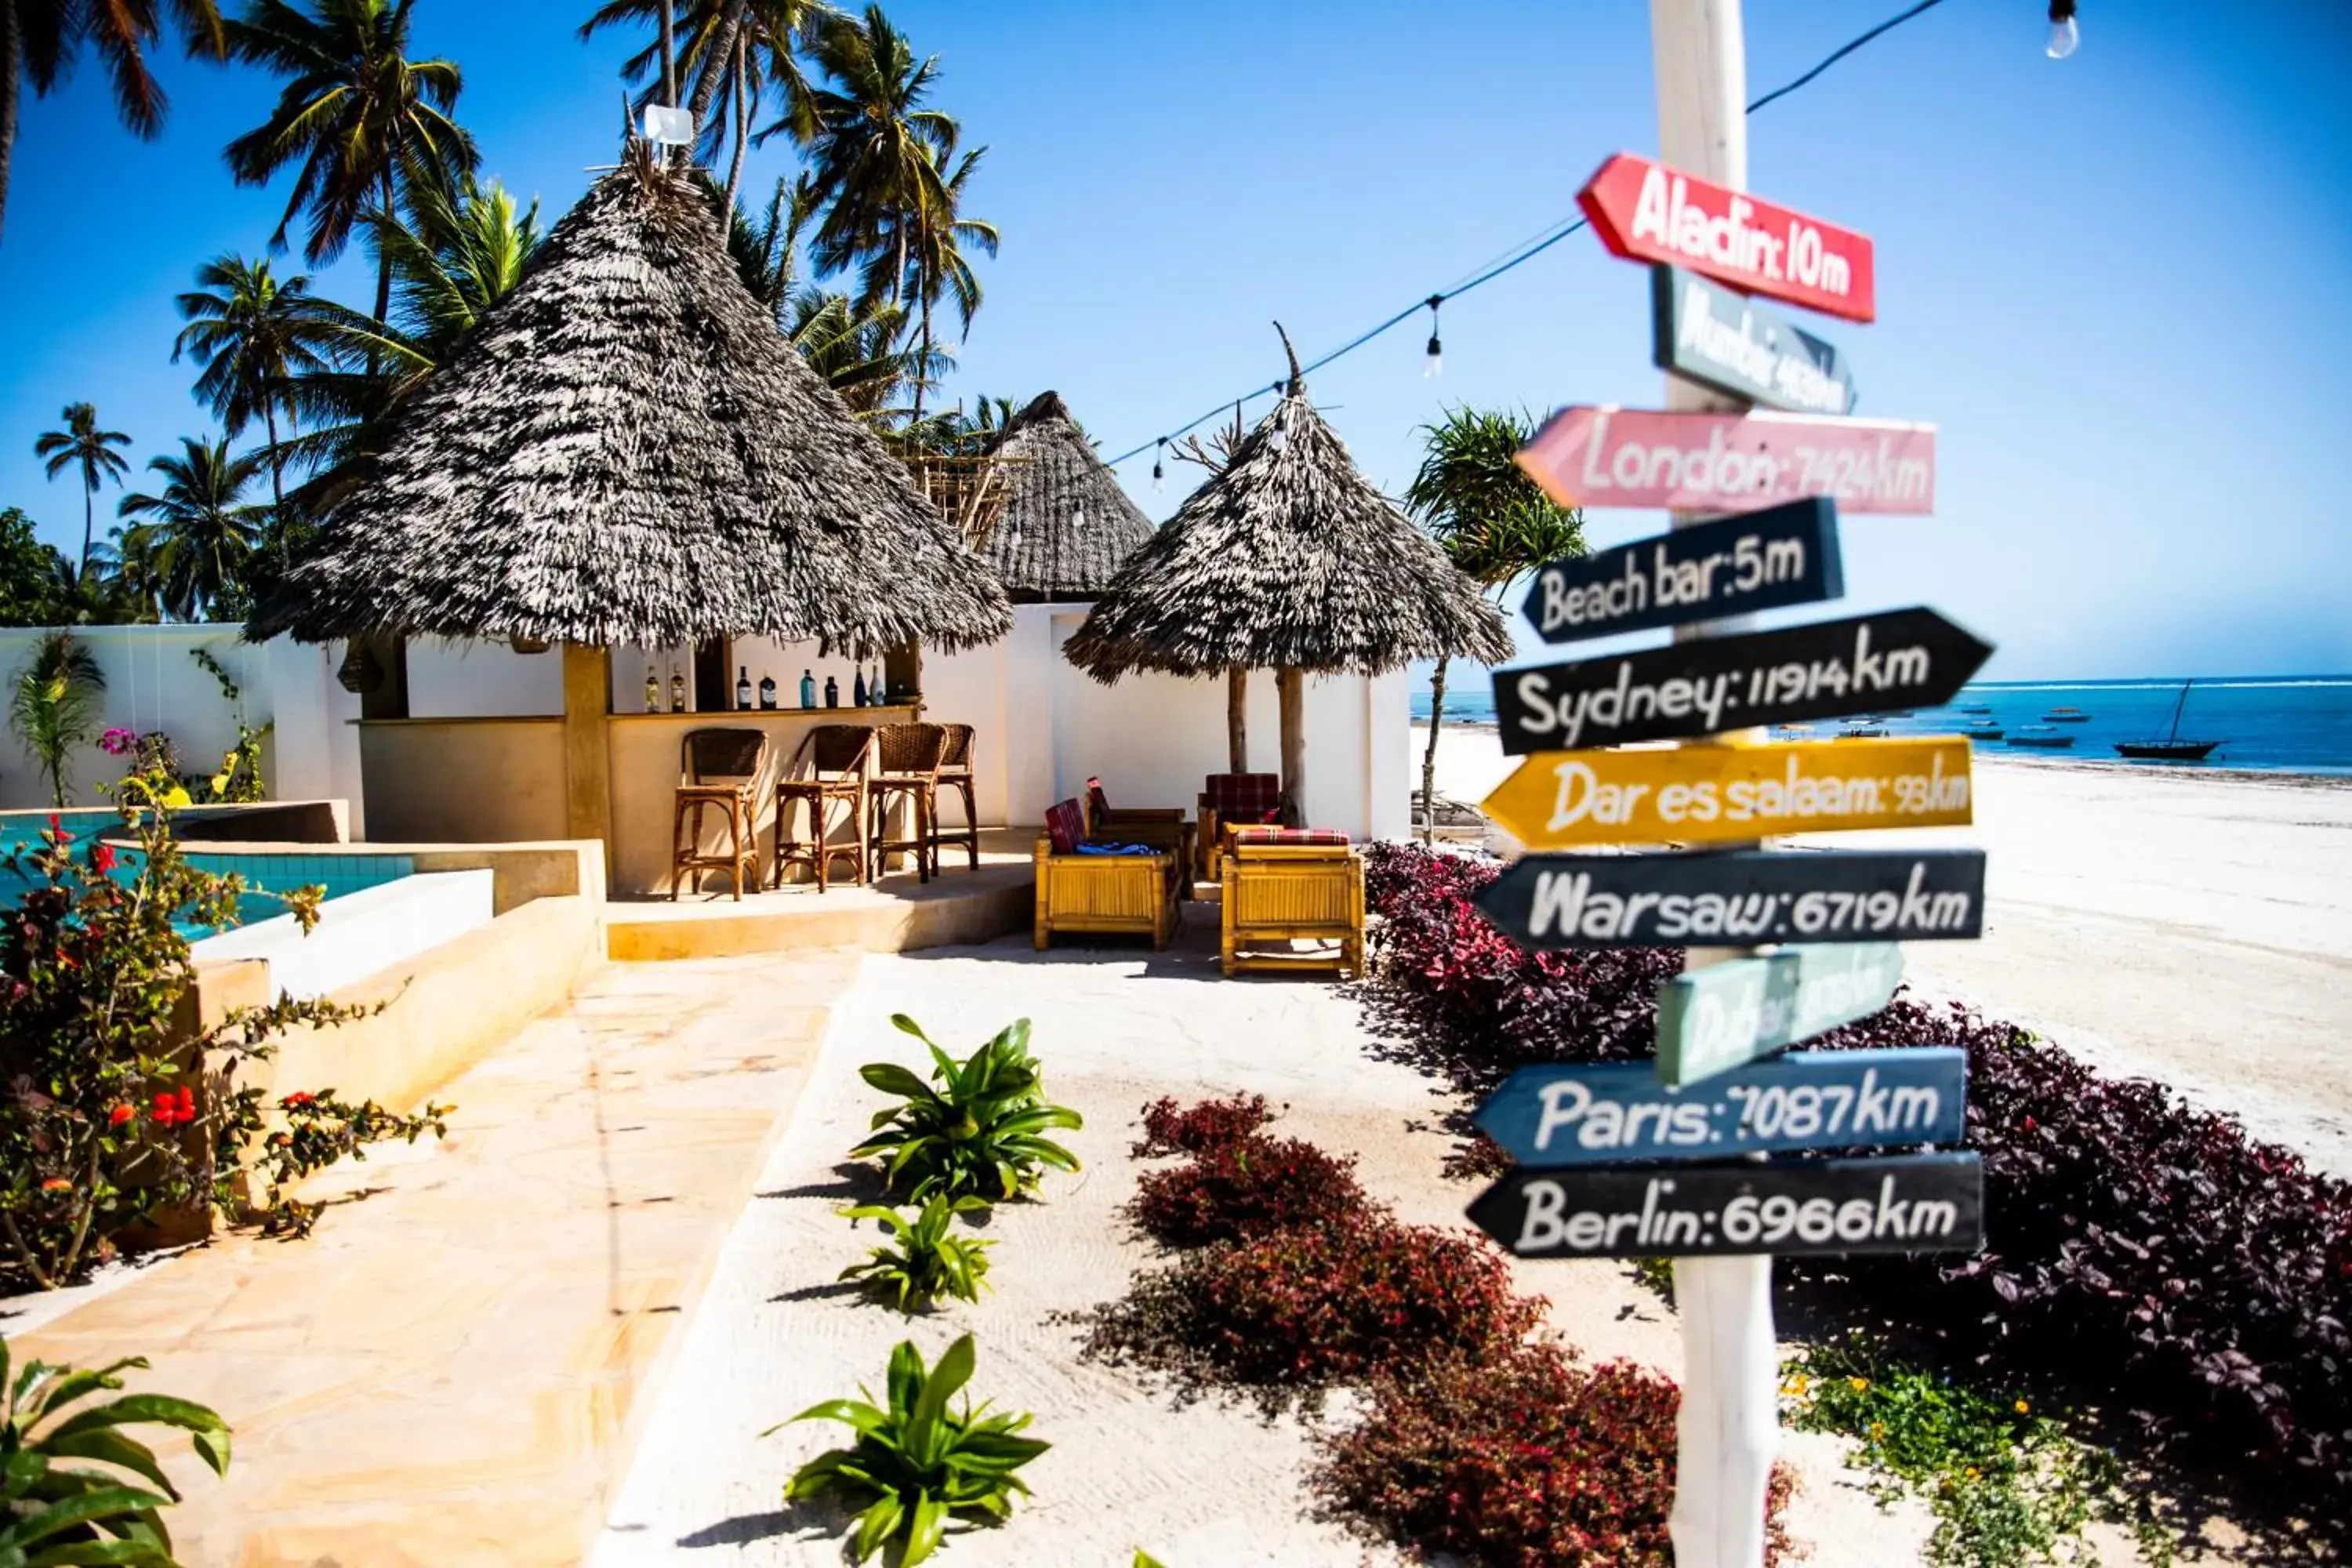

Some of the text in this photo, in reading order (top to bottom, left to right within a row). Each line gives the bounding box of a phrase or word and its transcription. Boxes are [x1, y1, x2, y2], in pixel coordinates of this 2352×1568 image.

[1541, 550, 1647, 632] Beach
[1545, 760, 1650, 833] Dar
[1657, 782, 1722, 822] es
